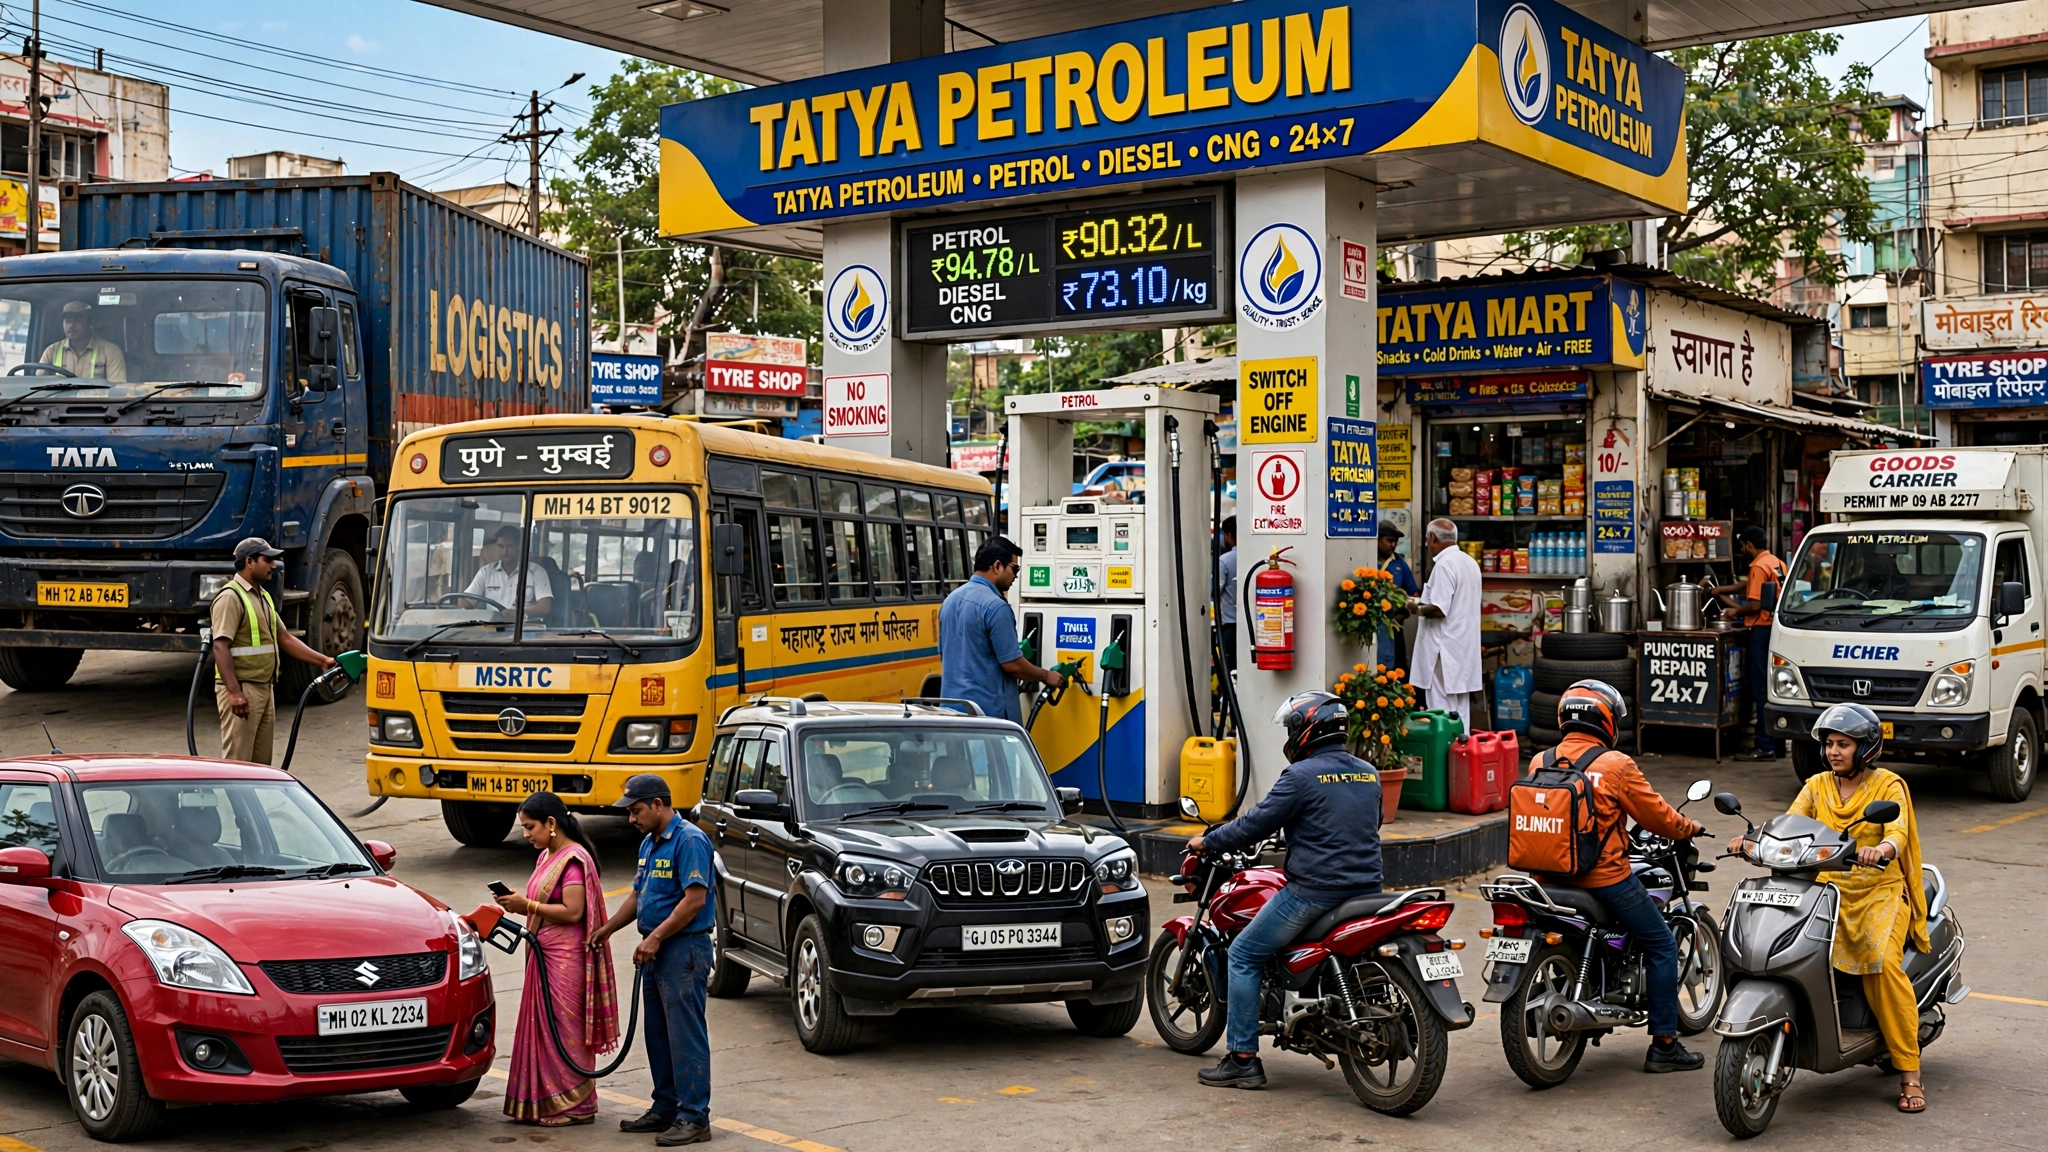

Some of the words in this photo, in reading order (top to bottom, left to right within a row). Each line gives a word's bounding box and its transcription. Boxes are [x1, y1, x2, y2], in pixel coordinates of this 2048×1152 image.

[1561, 26, 1643, 113] TATYA
[750, 80, 922, 172] TATYA
[938, 5, 1351, 146] PETROLEUM
[1556, 83, 1653, 159] PETROLEUM
[773, 186, 834, 215] TATYA
[839, 168, 964, 208] PETROLEUM
[990, 155, 1075, 190] PETROL
[1098, 141, 1181, 176] DIESEL
[1206, 130, 1260, 163] CNG
[932, 227, 1010, 251] PETROL
[939, 282, 1006, 306] DIESEL
[950, 304, 992, 324] CNG
[1377, 301, 1477, 344] TATYA
[1486, 291, 1593, 337] MART
[430, 289, 562, 389] LOGISTICS
[1377, 350, 1411, 365] Snacks
[1423, 347, 1446, 363] Cold
[1449, 345, 1481, 361] Drinks
[1493, 343, 1524, 359] Water
[1536, 341, 1552, 356] Air
[1564, 339, 1592, 355] FREE
[1670, 329, 1735, 379] स्वागत
[1740, 329, 1754, 387] है
[592, 362, 622, 380] TYRE
[624, 363, 659, 381] SHOP
[711, 367, 754, 388] TYRE
[758, 370, 802, 391] SHOP
[1249, 369, 1307, 389] SWITCH
[1931, 361, 1984, 379] TYRE
[1989, 358, 2047, 377] SHOP
[847, 381, 865, 401] NO
[1061, 394, 1098, 408] PETROL
[1264, 392, 1293, 411] OFF
[828, 404, 886, 427] SMOKING
[1250, 413, 1307, 434] ENGINE
[46, 447, 117, 468] TATA
[459, 438, 506, 477] पुणे
[537, 434, 614, 474] मुम्बई
[1332, 440, 1371, 465] TATYA
[1597, 451, 1629, 473] 10/-
[1869, 455, 1956, 472] GOODS
[1869, 472, 1958, 488] CARRIER
[544, 497, 571, 515] MH
[577, 497, 595, 515] 14
[601, 497, 623, 515] BT
[629, 496, 671, 514] 9012
[1844, 495, 1886, 508] PERMIT
[1890, 494, 1909, 508] MP
[1912, 494, 1927, 507] 09
[1930, 494, 1947, 507] AB
[1949, 493, 1980, 507] 2277
[45, 587, 60, 602] MH
[64, 588, 76, 602] 12
[79, 588, 93, 602] AB
[97, 588, 124, 603] 7645
[780, 625, 827, 654] महाराष्ट्र
[830, 623, 856, 646] राज्य
[860, 611, 880, 644] मार्ग
[882, 611, 919, 641] परिवहन
[1643, 642, 1715, 659] PUNCTURE
[1832, 644, 1900, 661] EICHER
[475, 666, 553, 688] MSRTC
[1650, 659, 1707, 677] REPAIR
[1650, 678, 1709, 705] 24x7
[471, 776, 487, 792] MH
[490, 777, 503, 792] 14
[505, 778, 520, 793] BT
[522, 778, 549, 794] 9012
[1516, 814, 1564, 834] BLINKIT
[971, 930, 986, 945] GJ
[990, 930, 1005, 944] 05
[1008, 929, 1024, 944] PQ
[1027, 927, 1057, 943] 3344
[329, 1010, 347, 1029] MH
[351, 1009, 367, 1027] 02
[371, 1007, 388, 1026] KL
[391, 1004, 424, 1024] 2234
